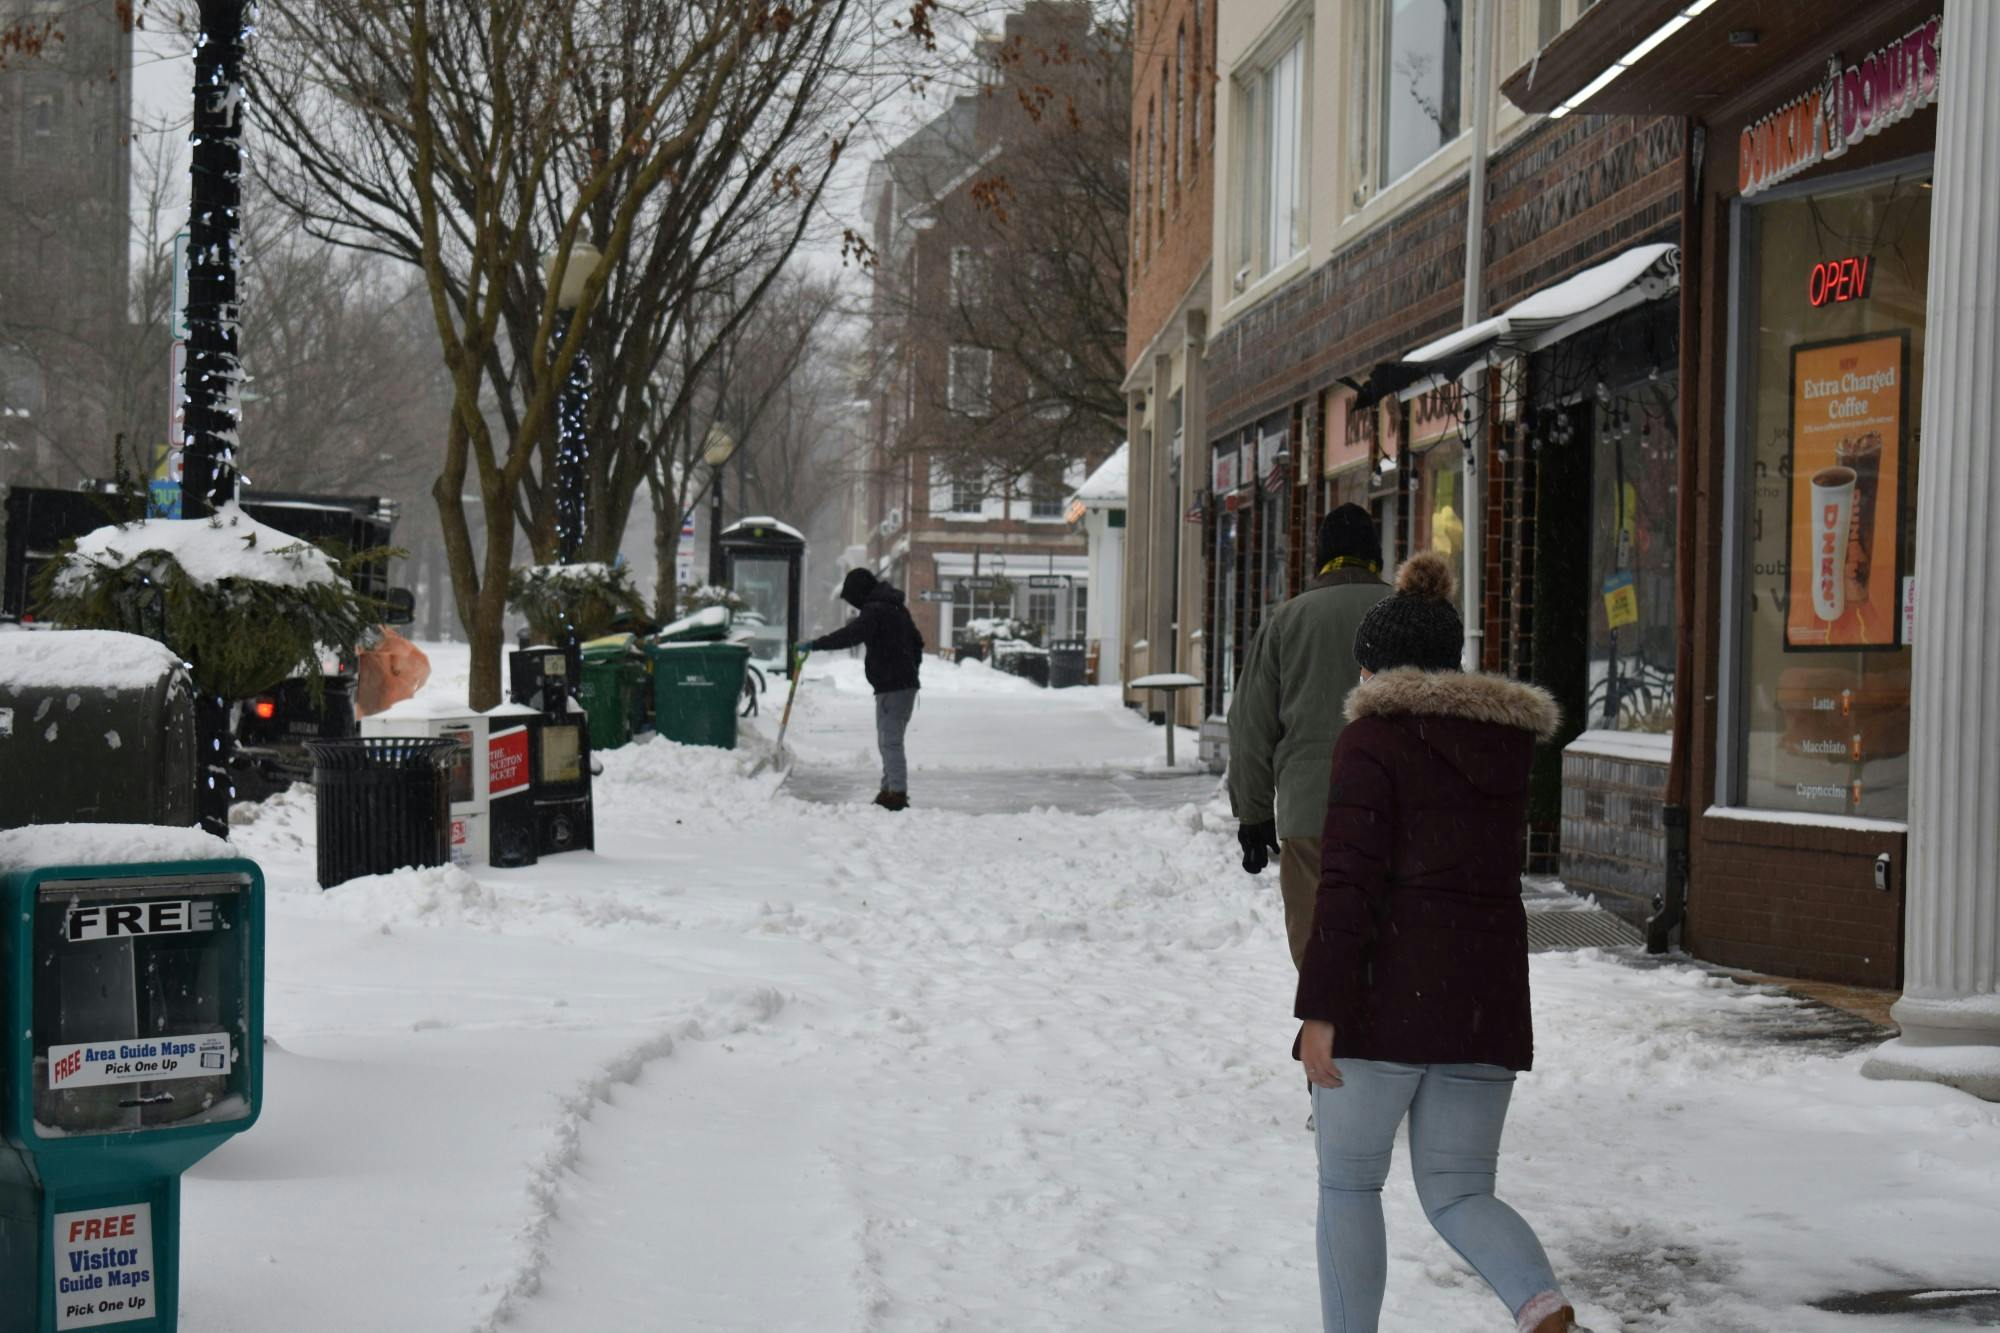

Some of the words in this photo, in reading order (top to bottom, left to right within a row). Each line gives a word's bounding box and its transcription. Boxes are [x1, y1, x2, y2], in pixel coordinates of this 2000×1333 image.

[1842, 16, 1941, 143] DONUTS
[1809, 256, 1869, 306] OPEN
[1803, 378, 1840, 400] Extra
[1841, 366, 1896, 394] Charged
[1828, 396, 1869, 420] Coffee
[1812, 696, 1836, 711] Latte
[489, 747, 505, 761] THE
[1802, 739, 1847, 754] Macchiato
[489, 753, 523, 771] NCETON
[1796, 782, 1847, 799] Cappuccino
[69, 901, 214, 940] FREE
[54, 1049, 81, 1083] FREE
[85, 1048, 116, 1062] Area
[120, 1045, 157, 1060] Guide
[161, 1042, 196, 1058] Maps
[105, 1063, 131, 1075] Pick
[135, 1061, 158, 1072] One
[162, 1059, 178, 1071] Up
[69, 1214, 136, 1243] FREE
[69, 1247, 138, 1273] Visitor
[60, 1274, 103, 1294] Guide
[108, 1269, 150, 1287] Maps
[66, 1303, 95, 1318] Pick
[98, 1301, 124, 1313] One
[128, 1296, 146, 1310] Up
